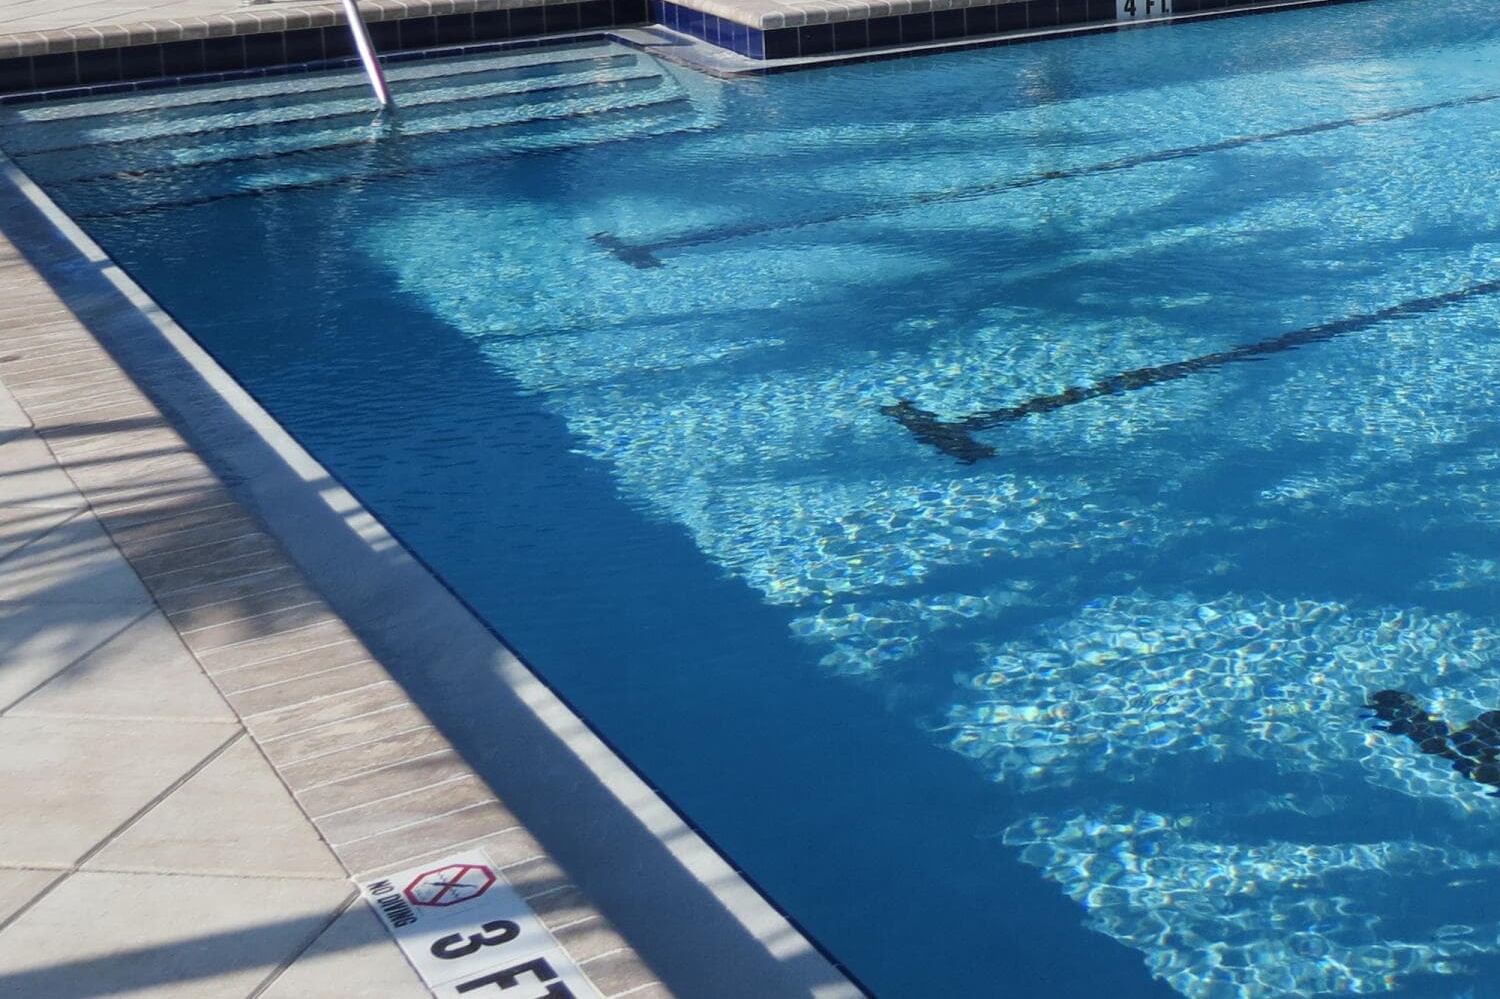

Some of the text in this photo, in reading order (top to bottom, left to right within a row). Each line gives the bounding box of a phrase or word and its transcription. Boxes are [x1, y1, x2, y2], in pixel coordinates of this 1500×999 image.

[366, 878, 418, 929] NO DIVING
[430, 919, 521, 960] 3
